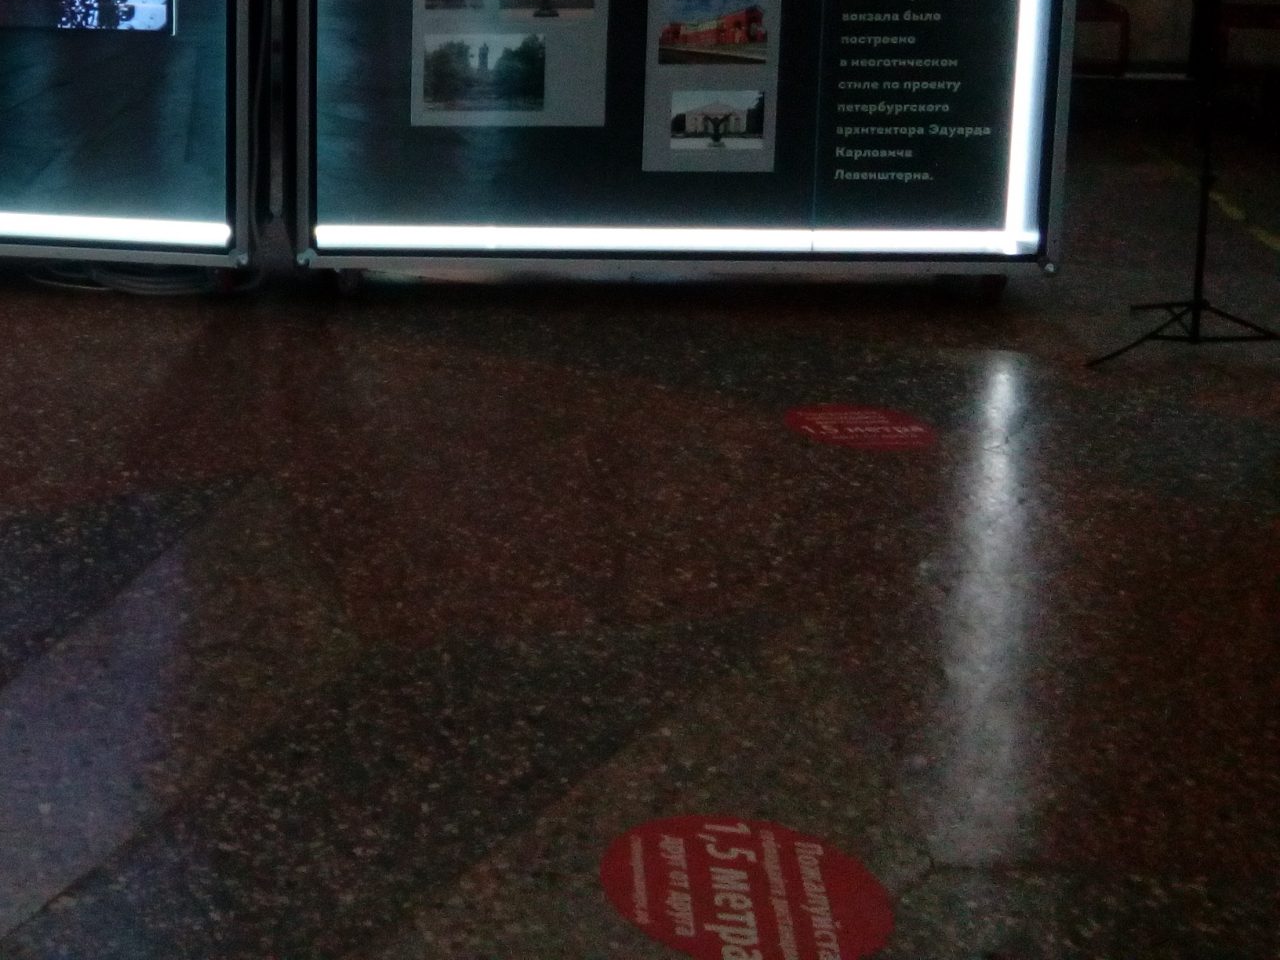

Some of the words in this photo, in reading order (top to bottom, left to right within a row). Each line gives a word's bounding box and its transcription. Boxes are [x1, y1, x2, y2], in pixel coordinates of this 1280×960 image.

[841, 12, 900, 22] вокзала
[903, 9, 942, 21] было
[840, 36, 916, 48] построено
[851, 58, 959, 68] неоготическом
[838, 81, 879, 90] стиле
[882, 81, 900, 89] по
[903, 80, 961, 93] проекту
[837, 101, 950, 115] петербургского
[836, 125, 925, 137] архитектора
[928, 124, 992, 138] Эдуарда
[835, 147, 913, 160] Карловича
